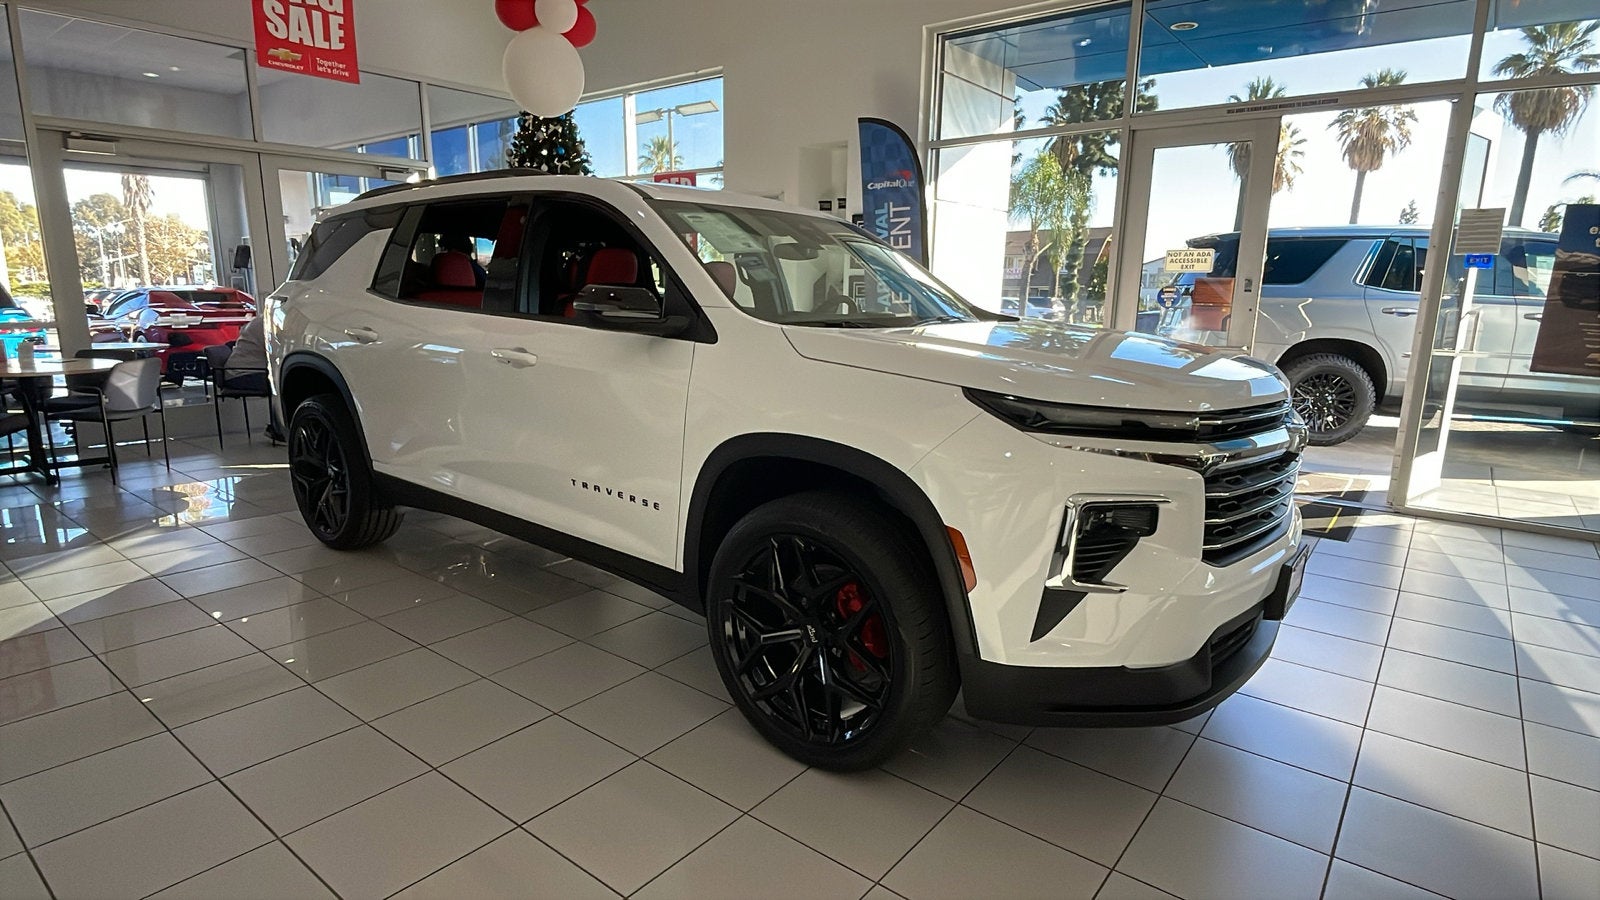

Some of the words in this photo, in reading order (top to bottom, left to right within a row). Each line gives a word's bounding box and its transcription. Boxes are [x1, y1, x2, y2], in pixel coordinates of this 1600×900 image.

[263, 0, 344, 49] SALE
[268, 60, 304, 70] CHEVROLET
[316, 58, 346, 69] Together
[317, 65, 332, 74] let's
[332, 67, 350, 77] drive
[570, 478, 660, 511] TRAVERSE
